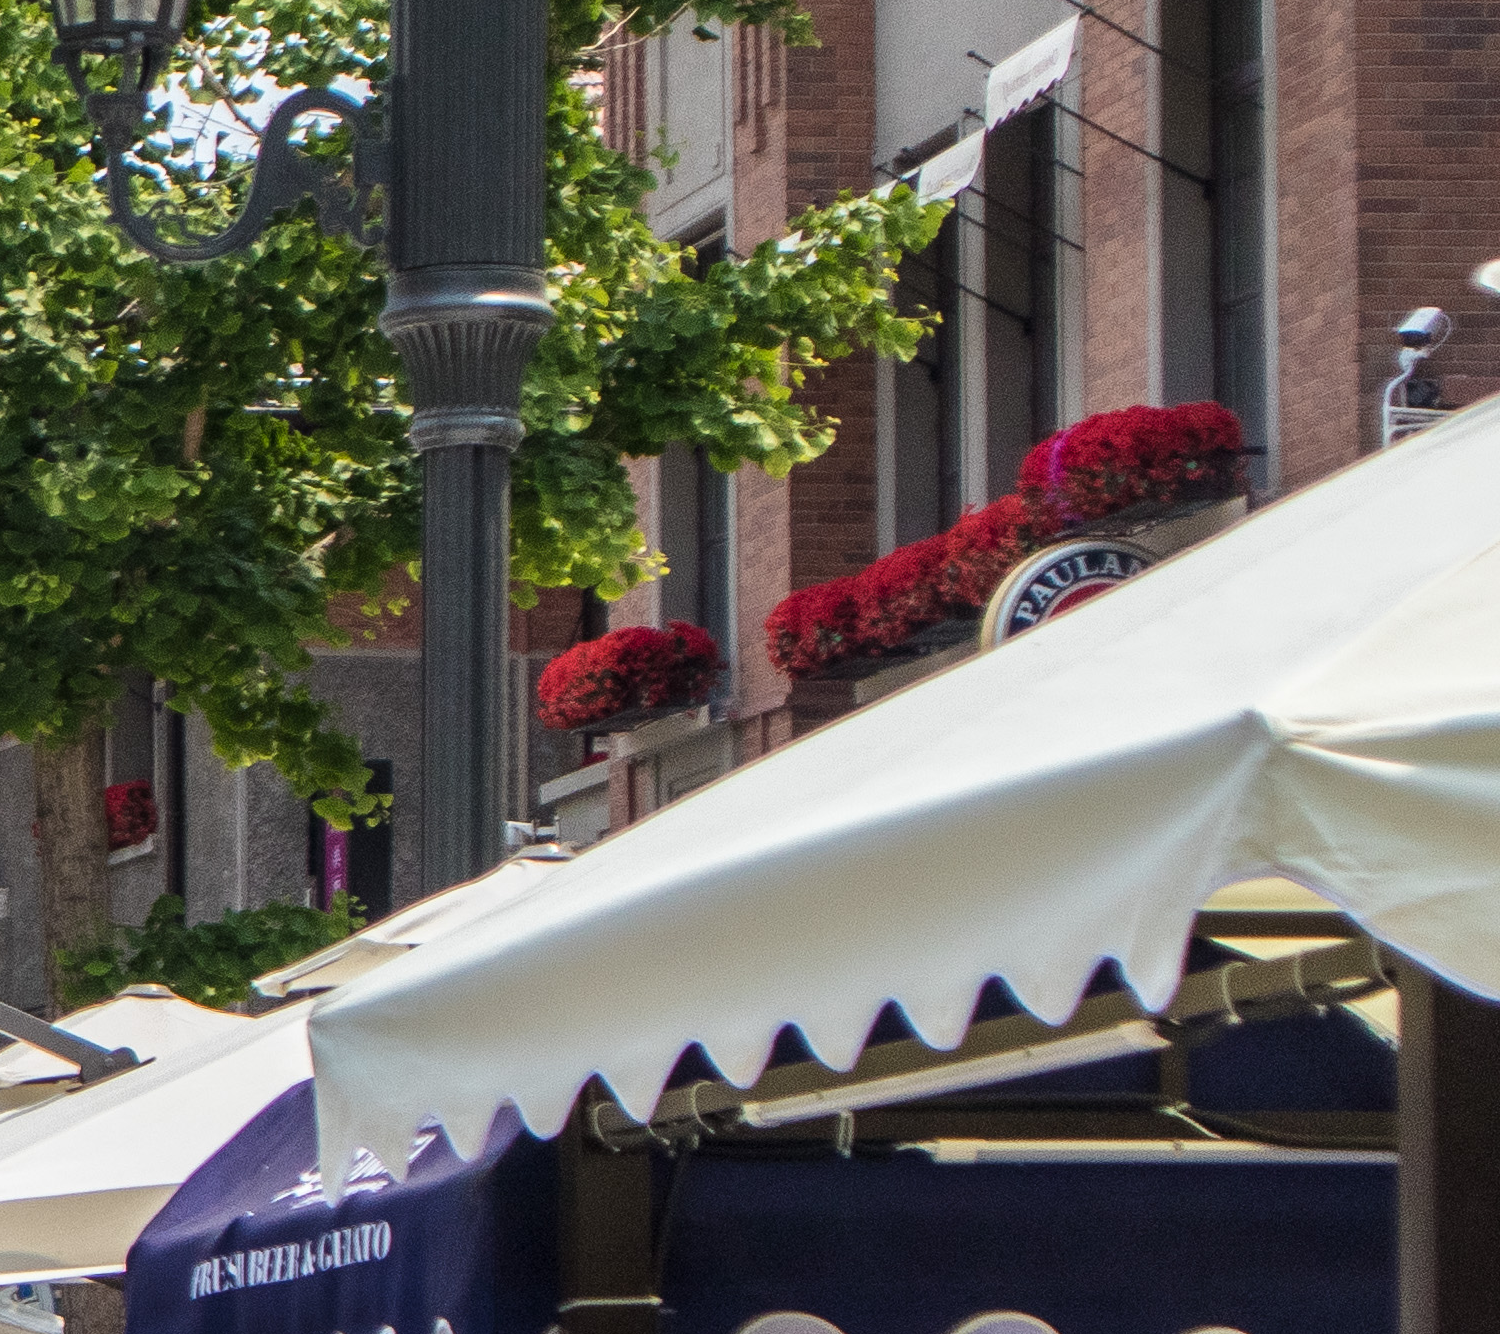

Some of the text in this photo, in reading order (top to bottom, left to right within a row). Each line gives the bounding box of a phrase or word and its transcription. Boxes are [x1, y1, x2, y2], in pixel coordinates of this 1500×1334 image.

[189, 1219, 393, 1301] FRESH BEER & GELATO
